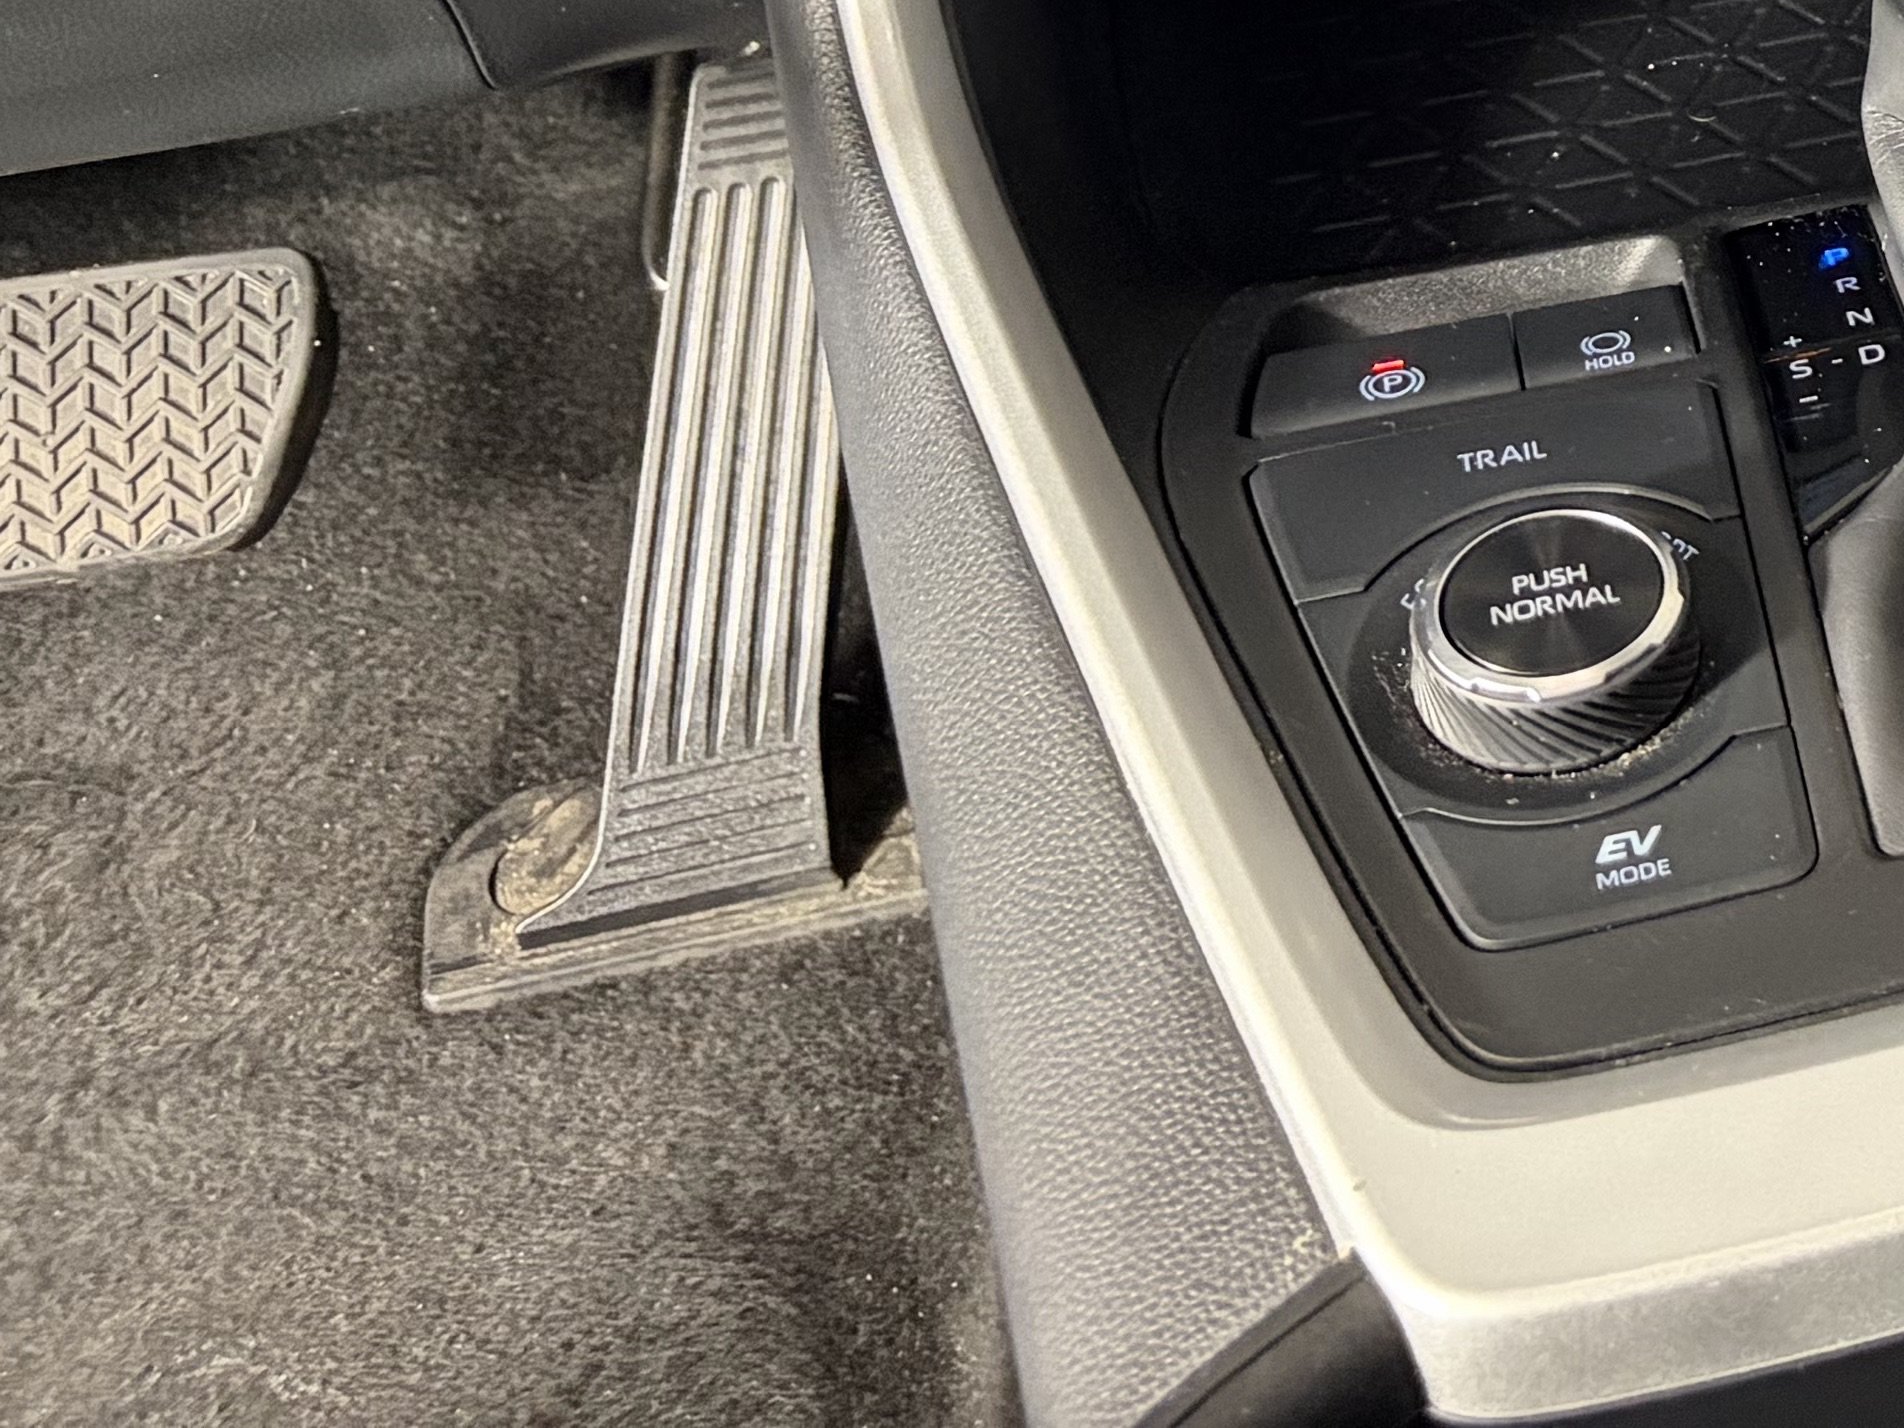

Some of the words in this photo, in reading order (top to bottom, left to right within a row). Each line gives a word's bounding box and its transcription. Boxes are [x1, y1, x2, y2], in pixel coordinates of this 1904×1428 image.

[1822, 247, 1849, 266] P
[1834, 277, 1861, 293] R
[1845, 307, 1875, 326] N
[1584, 350, 1635, 371] HOLD
[1789, 358, 1813, 379] S
[1858, 344, 1886, 365] D
[1457, 440, 1548, 473] TRAIL
[1511, 563, 1588, 595] PUSH
[1489, 584, 1620, 627] NORMAL
[1595, 824, 1662, 865] EV
[1596, 856, 1672, 891] MODE
